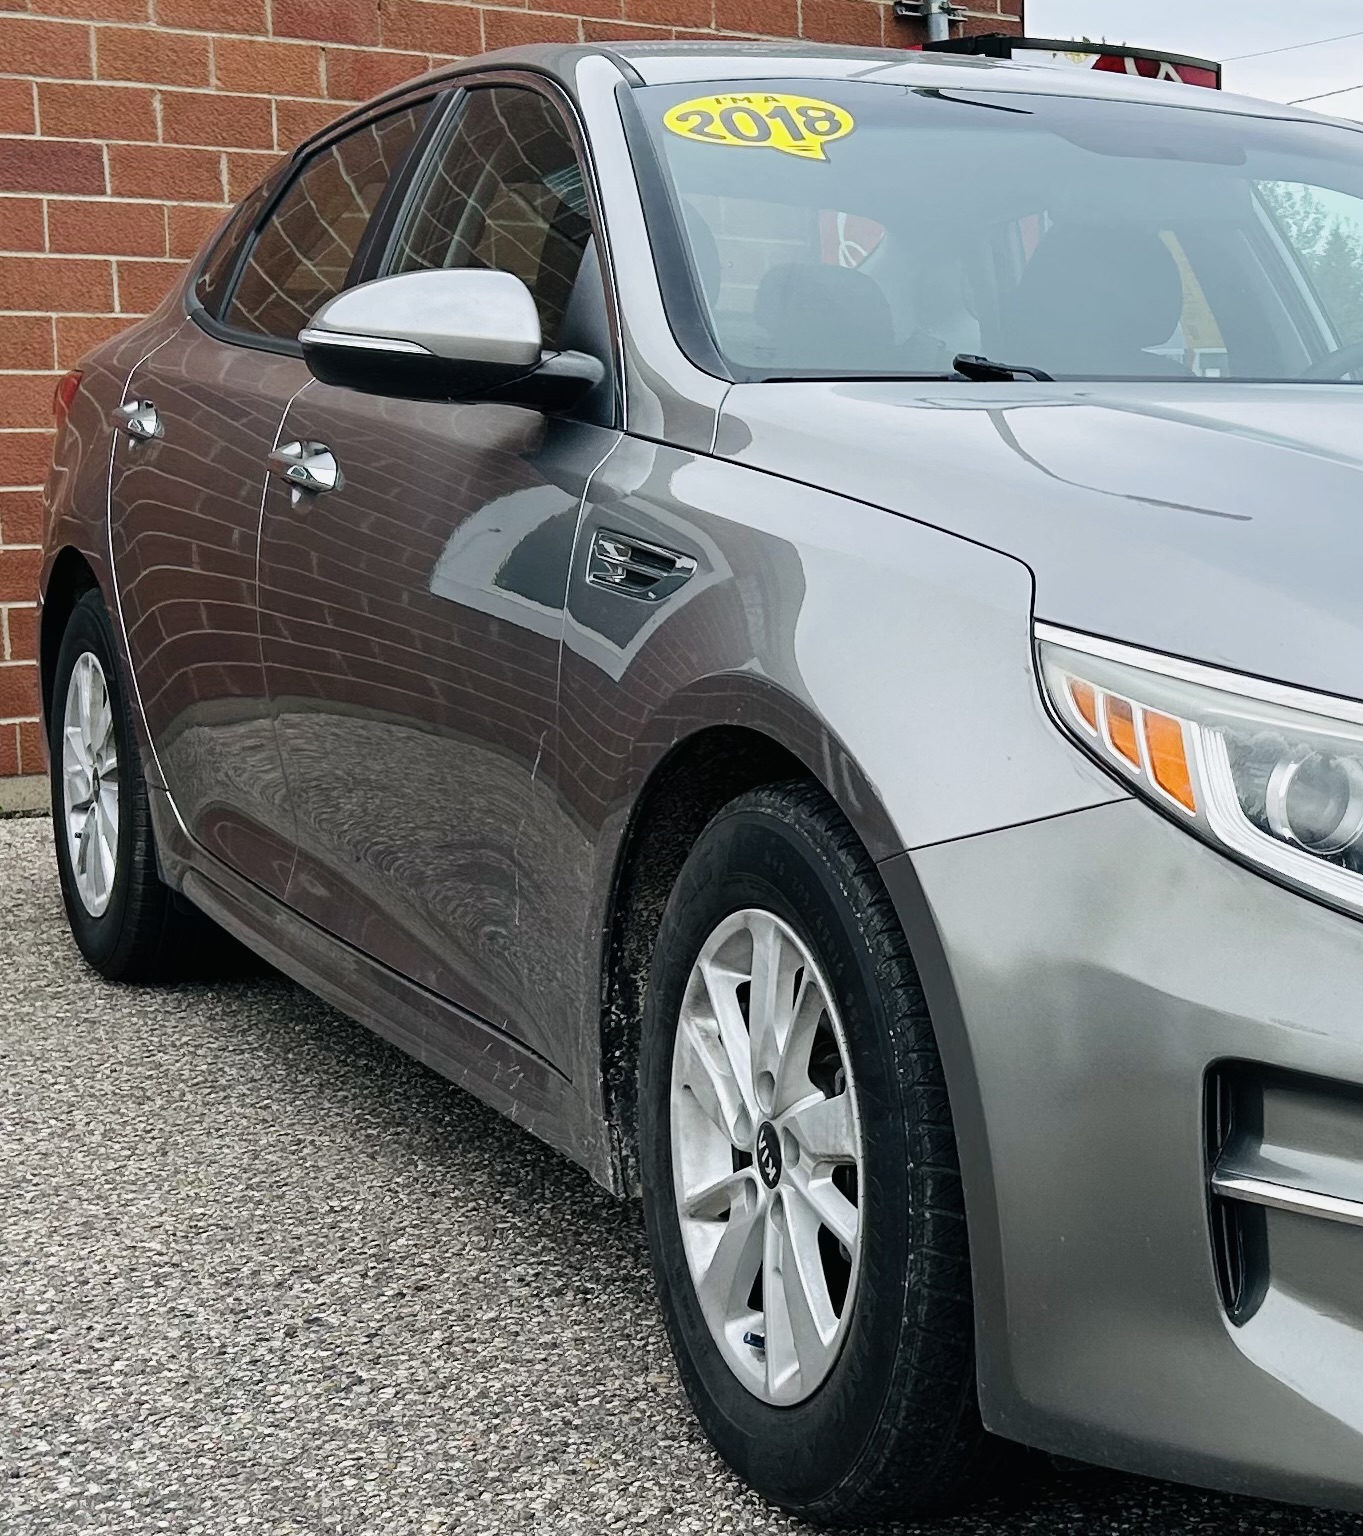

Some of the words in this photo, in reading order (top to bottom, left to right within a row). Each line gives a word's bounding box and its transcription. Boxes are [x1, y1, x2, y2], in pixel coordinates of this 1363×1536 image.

[714, 96, 754, 105] I'M
[763, 95, 781, 104] A
[675, 105, 843, 143] 2018
[757, 1128, 778, 1182] KIA
